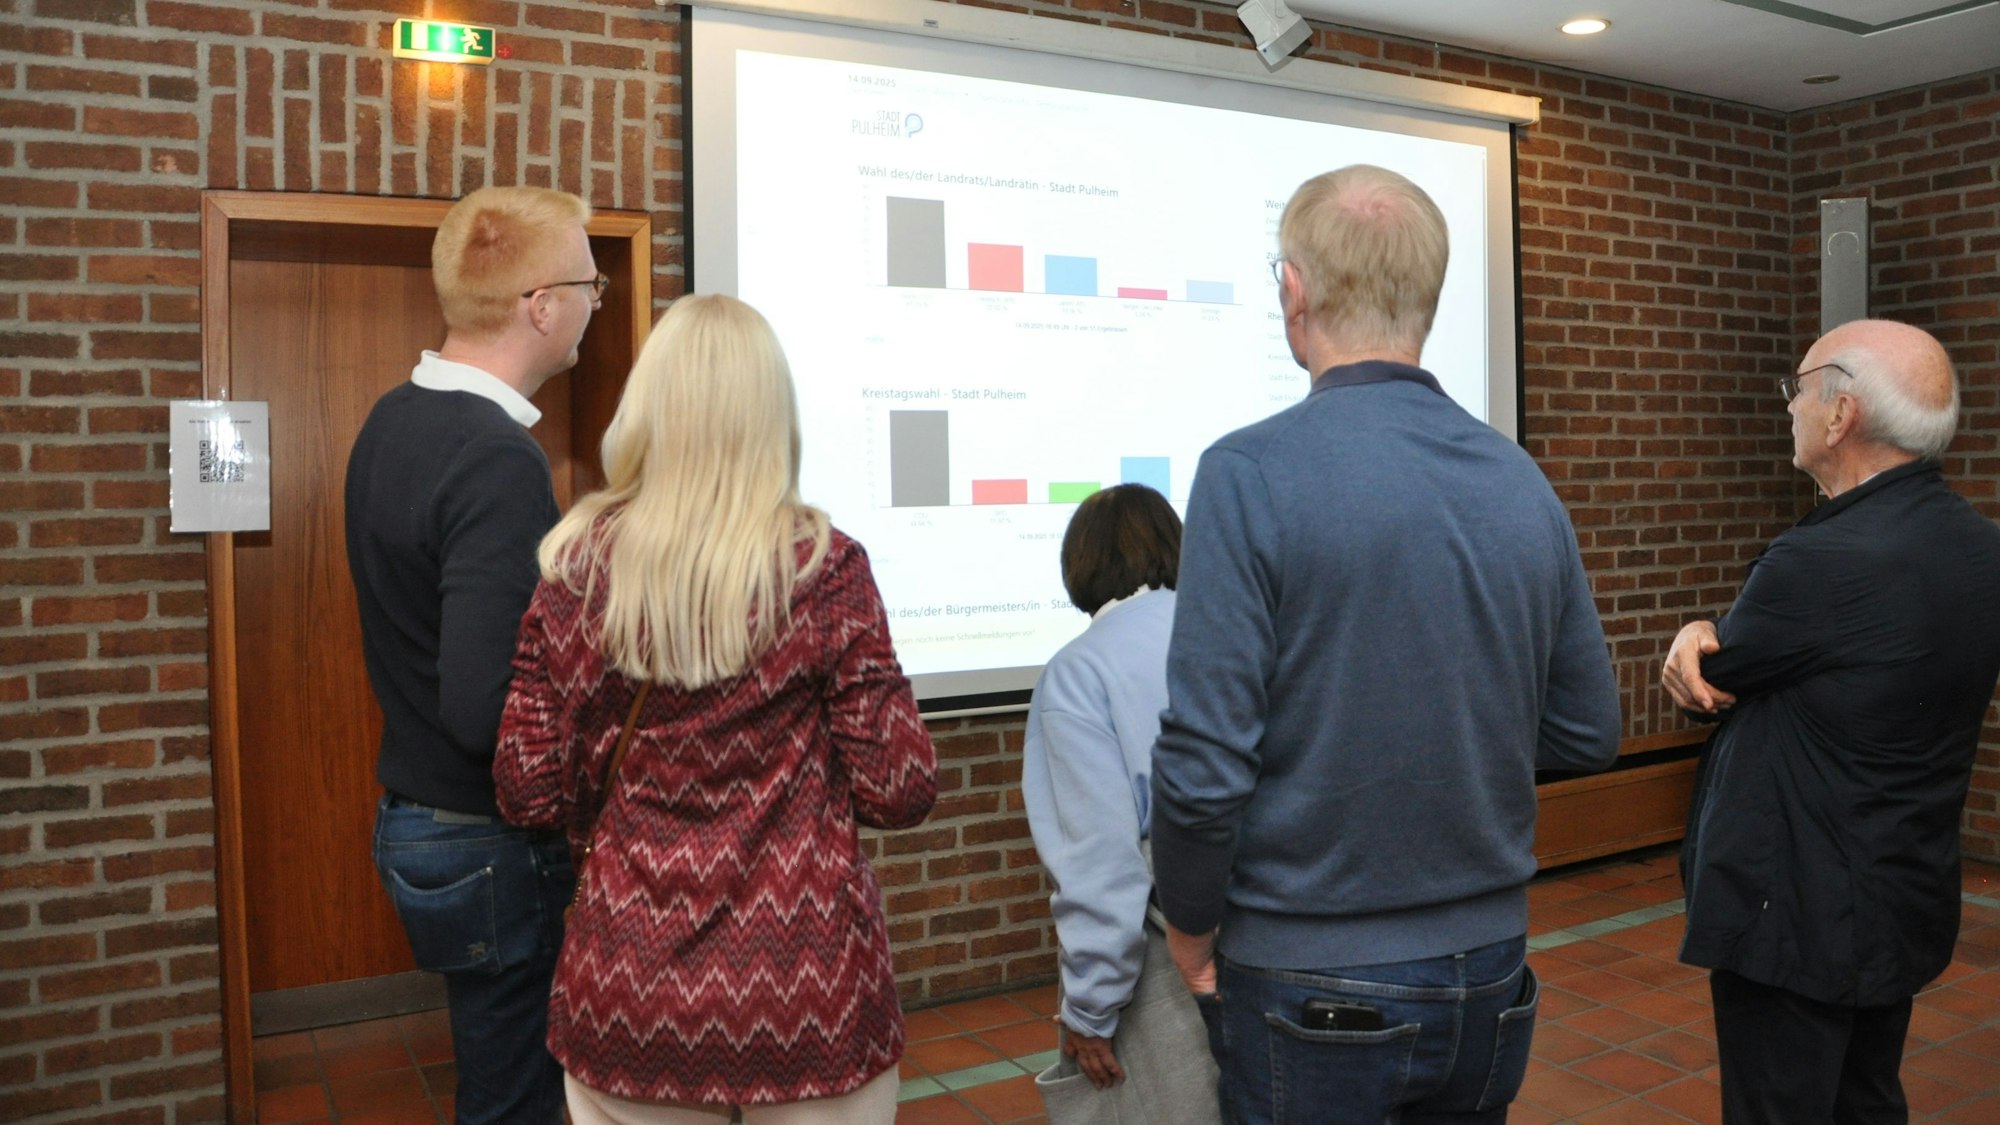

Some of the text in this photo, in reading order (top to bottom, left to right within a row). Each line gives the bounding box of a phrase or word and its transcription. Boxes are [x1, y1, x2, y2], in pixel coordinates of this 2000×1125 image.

[848, 74, 896, 87] 14.09.2025
[876, 110, 900, 122] STADT
[851, 119, 901, 137] PULHEIM
[858, 165, 887, 177] Wahl
[890, 168, 933, 182] des/der
[1049, 181, 1076, 194] Stadt
[1079, 184, 1119, 198] Pulheim
[1265, 200, 1285, 209] Weit
[862, 388, 940, 402] Kreistagswahl
[951, 388, 979, 400] Stadt
[983, 389, 1026, 401] Pulheim
[899, 604, 942, 619] des/der
[946, 600, 1040, 617] Bürgermeisters/in
[1050, 599, 1075, 610] Stad
